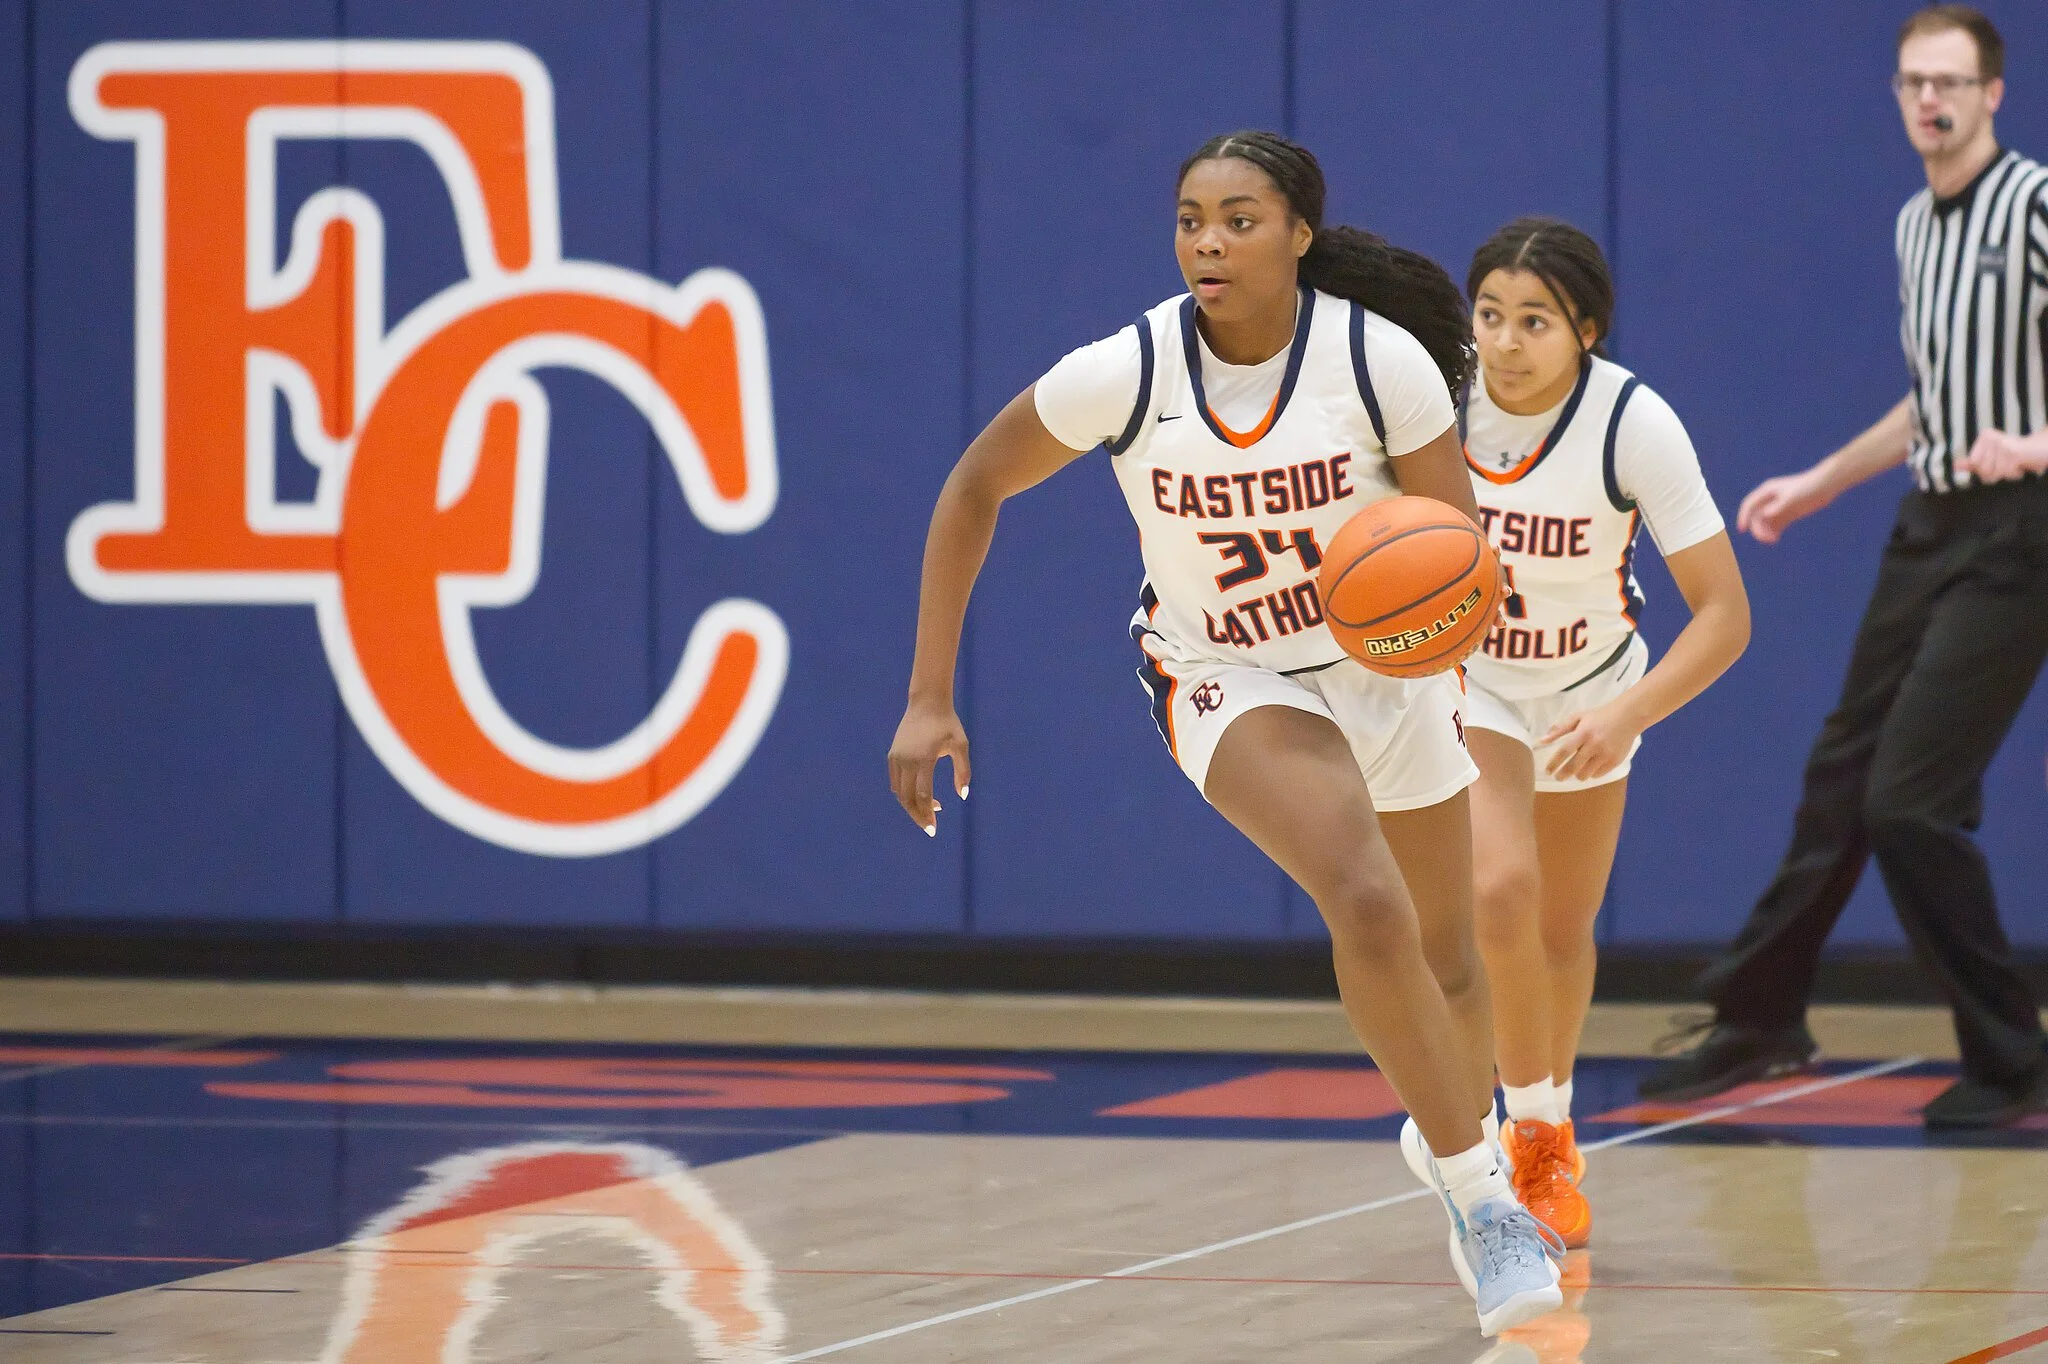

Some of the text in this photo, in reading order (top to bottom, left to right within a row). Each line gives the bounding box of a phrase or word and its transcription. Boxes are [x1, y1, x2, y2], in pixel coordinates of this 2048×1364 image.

[67, 40, 790, 858] EC
[1151, 452, 1354, 519] EASTSIDE
[1197, 527, 1324, 593] 34
[1479, 505, 1593, 558] TSIDE
[1200, 577, 1327, 649] CATHO
[1364, 586, 1482, 657] ELITE PRO
[1482, 617, 1589, 660] HOLIC
